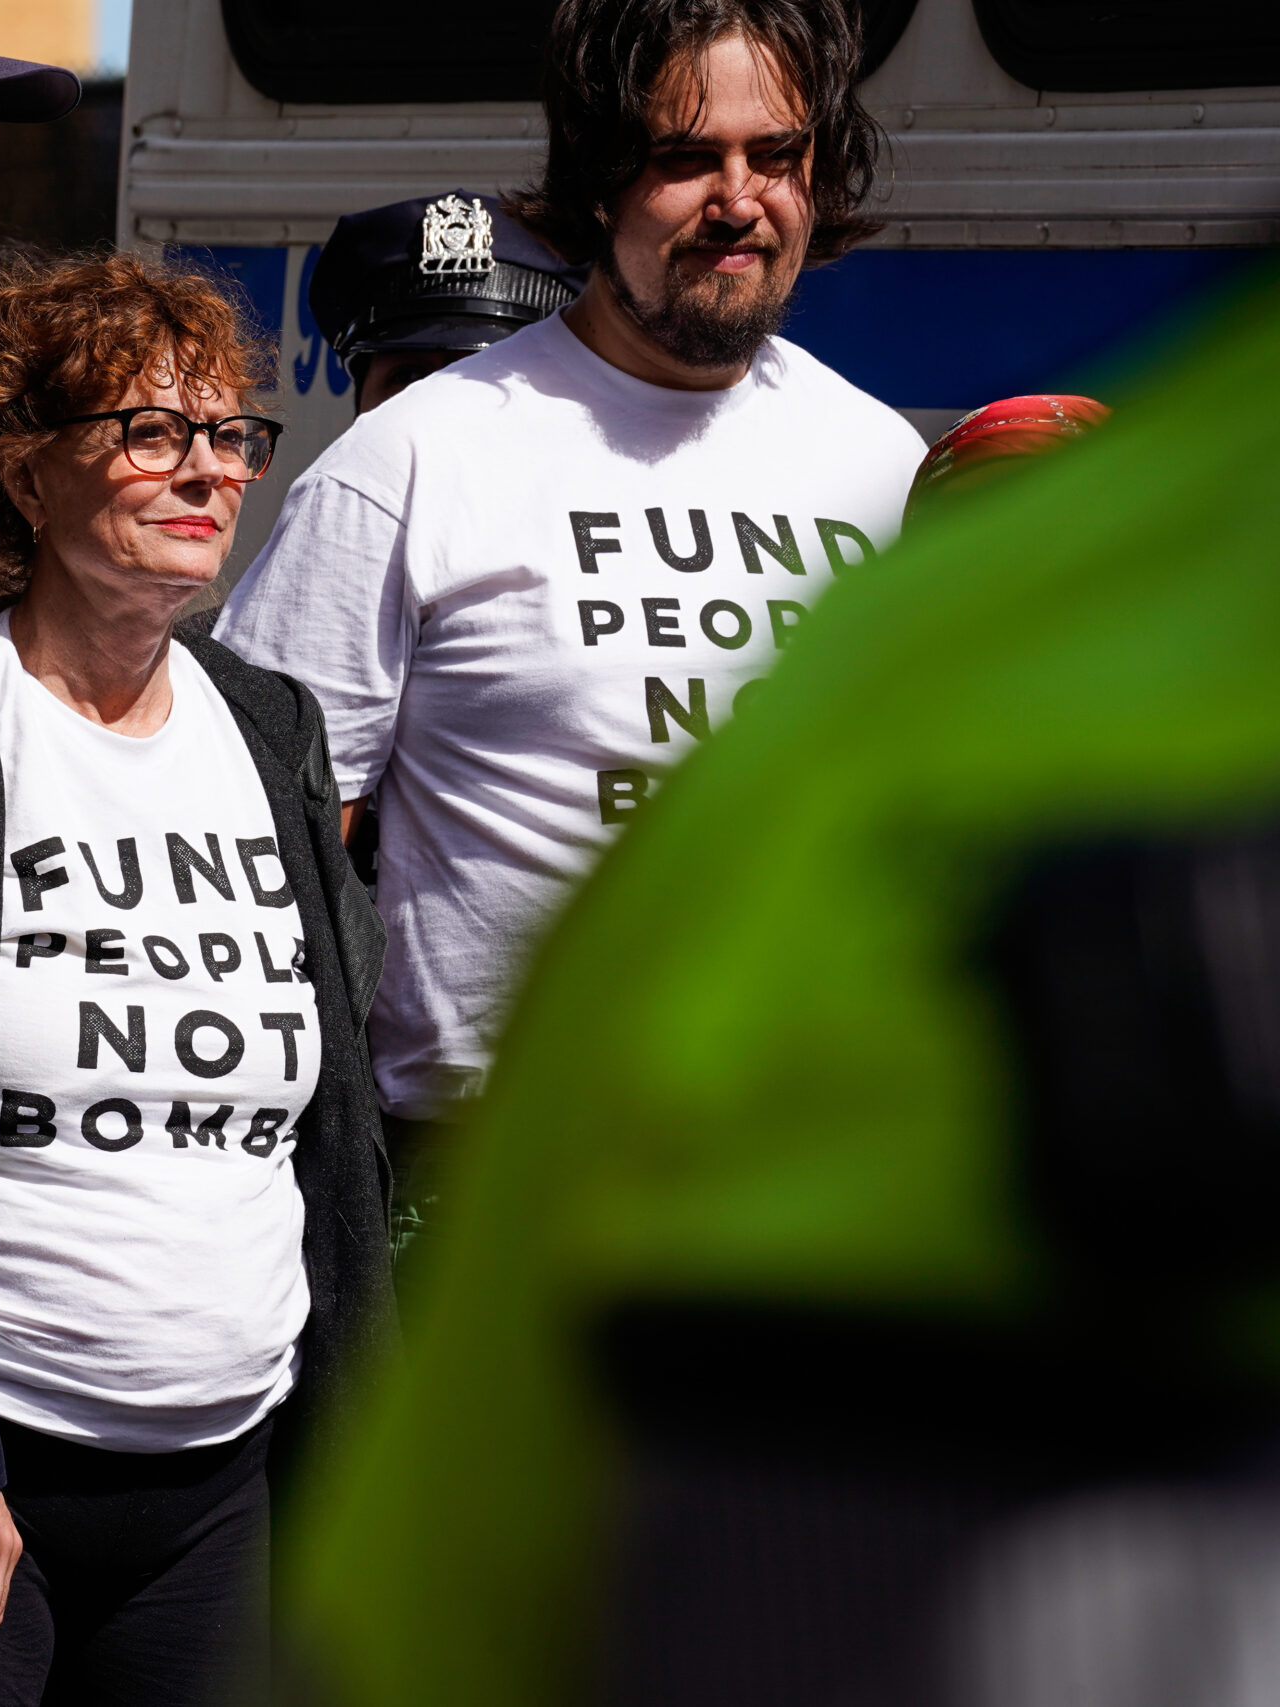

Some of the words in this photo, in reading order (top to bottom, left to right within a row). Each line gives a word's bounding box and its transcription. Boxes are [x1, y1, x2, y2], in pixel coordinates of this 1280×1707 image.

[569, 506, 878, 577] FUND
[577, 597, 812, 651] PEOP
[10, 832, 296, 912] FUND
[76, 1001, 307, 1082] NOT
